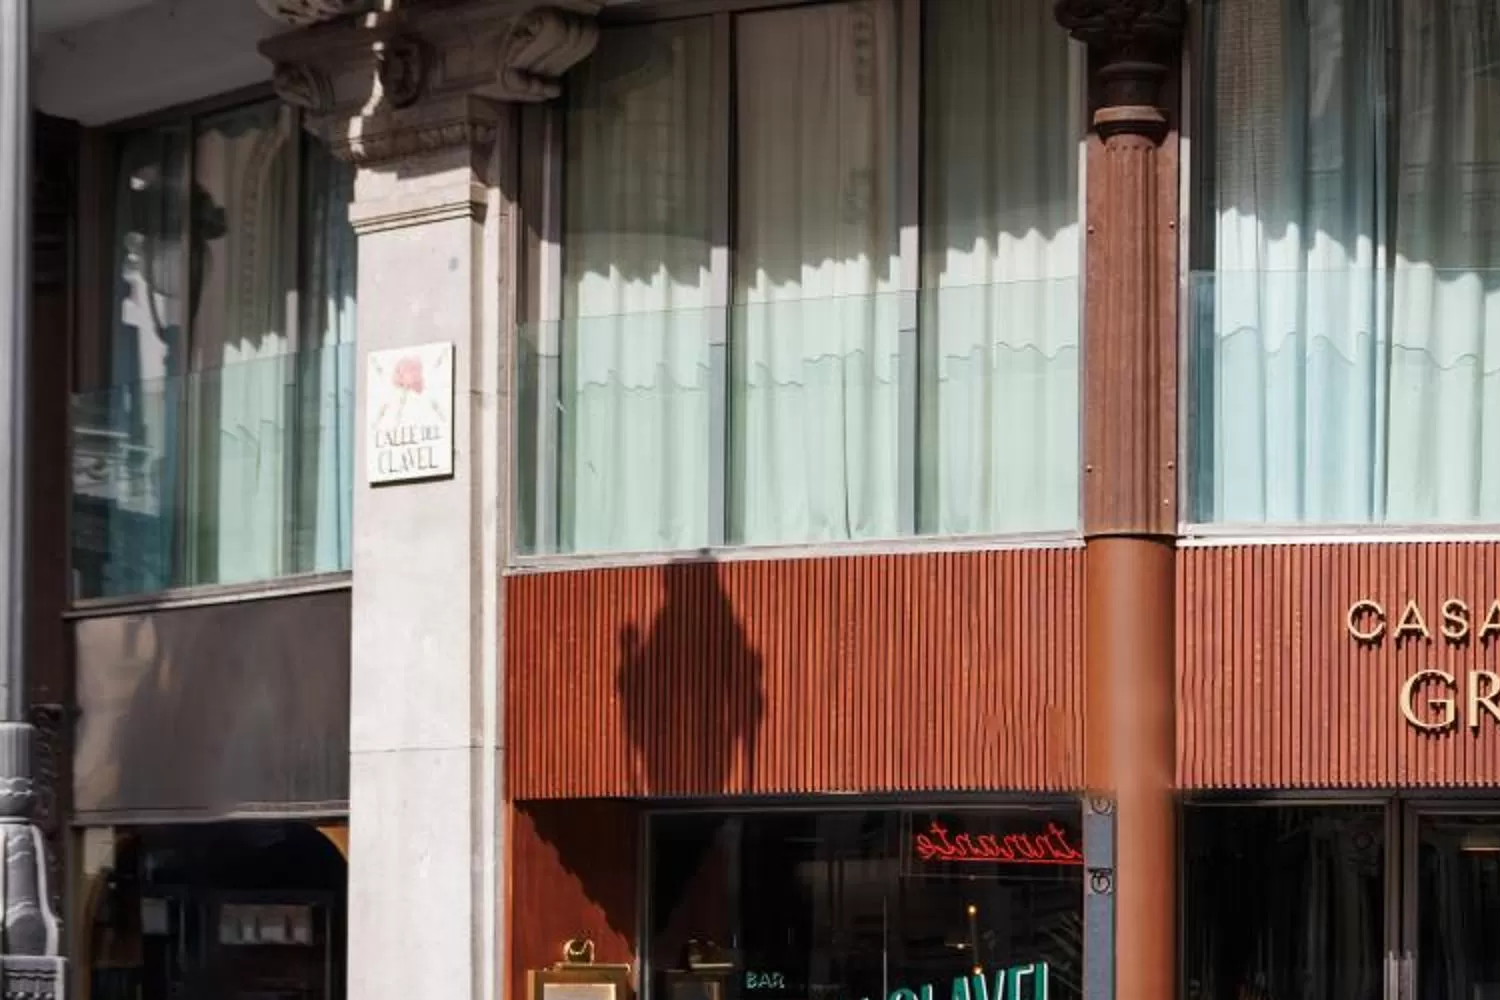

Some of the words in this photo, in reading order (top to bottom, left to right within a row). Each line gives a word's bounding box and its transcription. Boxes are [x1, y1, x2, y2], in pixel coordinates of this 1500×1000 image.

[375, 425, 419, 448] CALLE
[421, 425, 444, 441] DEL
[377, 446, 440, 474] CLAVEL
[746, 971, 785, 989] BAR
